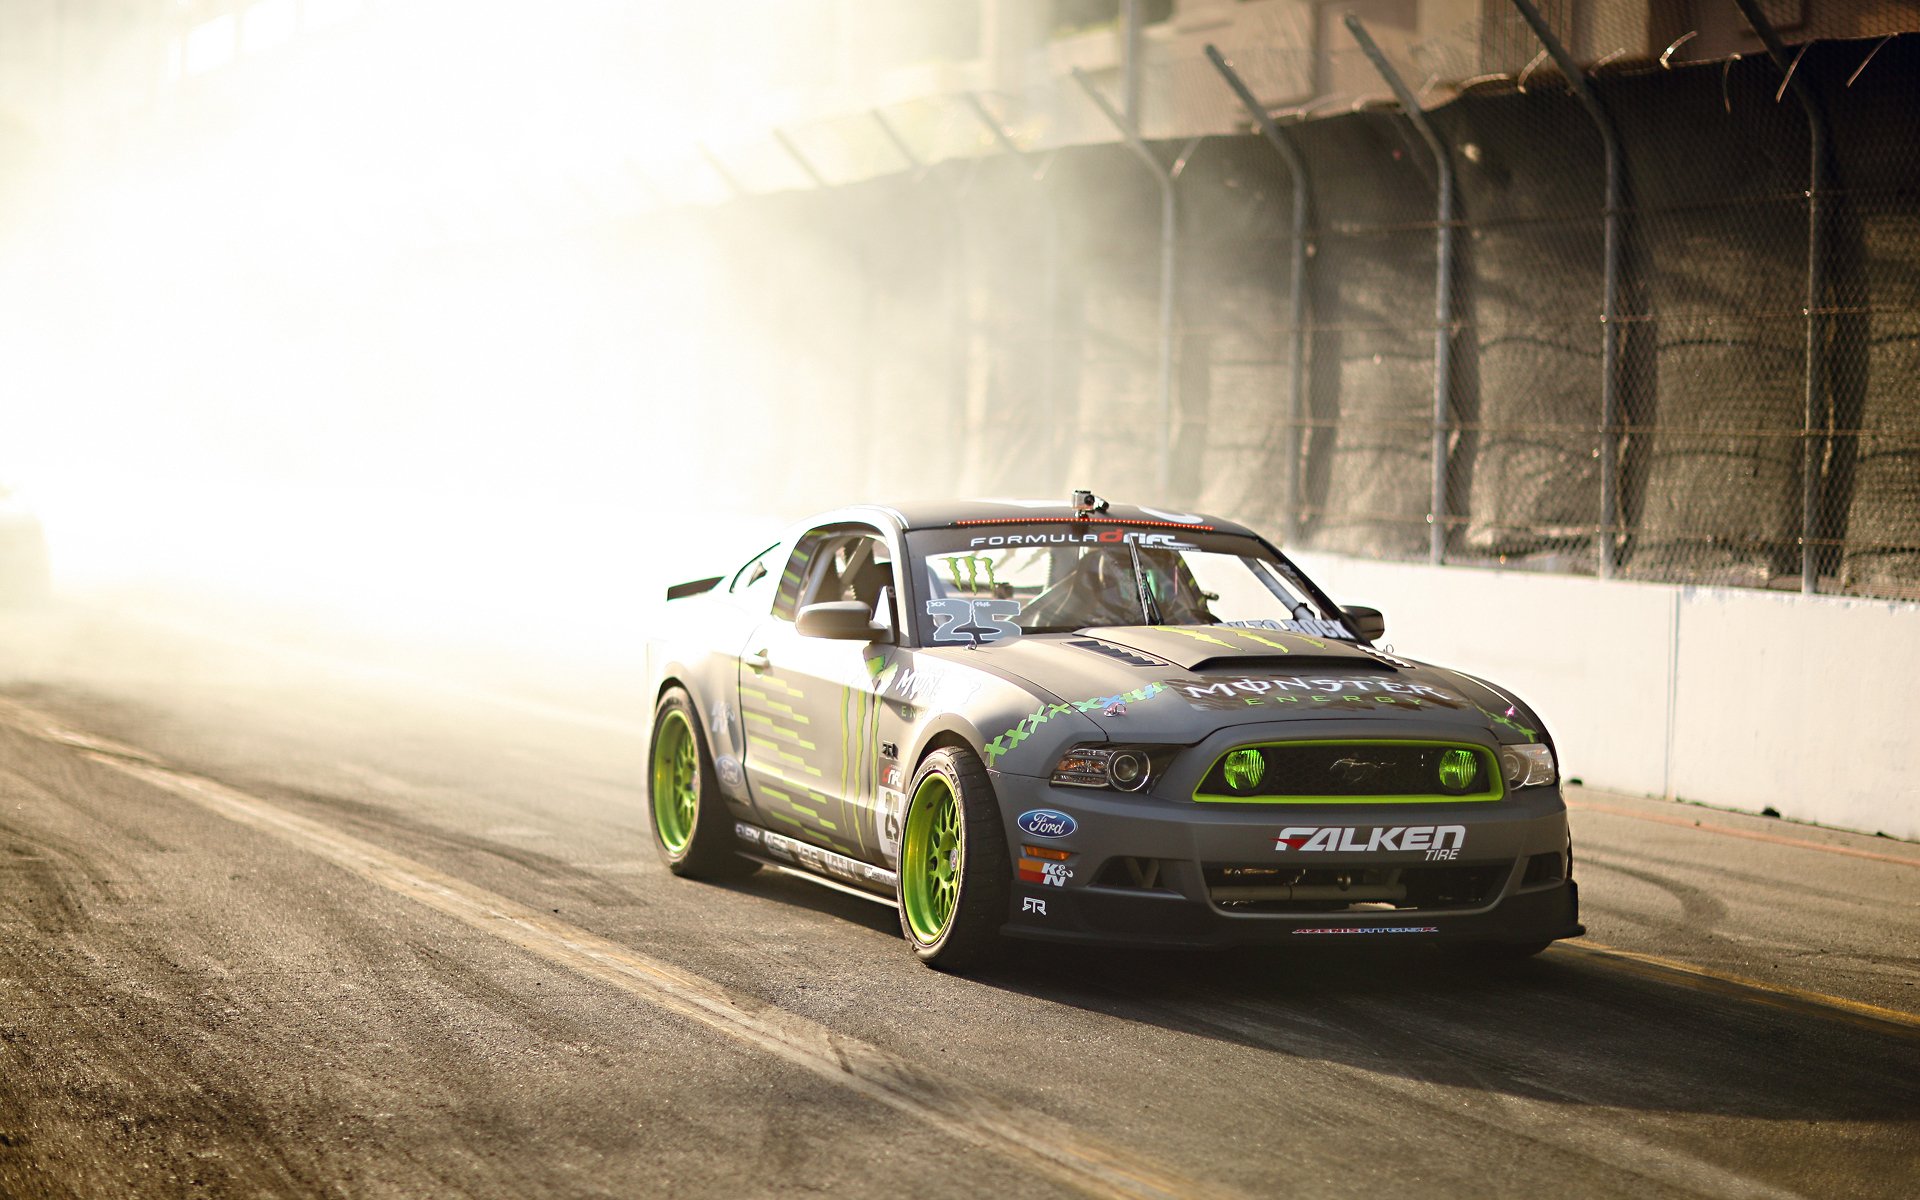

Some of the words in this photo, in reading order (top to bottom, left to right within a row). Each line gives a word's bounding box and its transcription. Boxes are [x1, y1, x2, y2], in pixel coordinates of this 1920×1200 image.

[926, 599, 1023, 641] 25
[1184, 677, 1452, 700] MONSTER
[1242, 695, 1423, 706] ENERGY
[1029, 812, 1066, 835] Ford
[1270, 825, 1466, 851] FALKEN
[1424, 849, 1460, 861] TIRE
[1041, 862, 1074, 887] K&N
